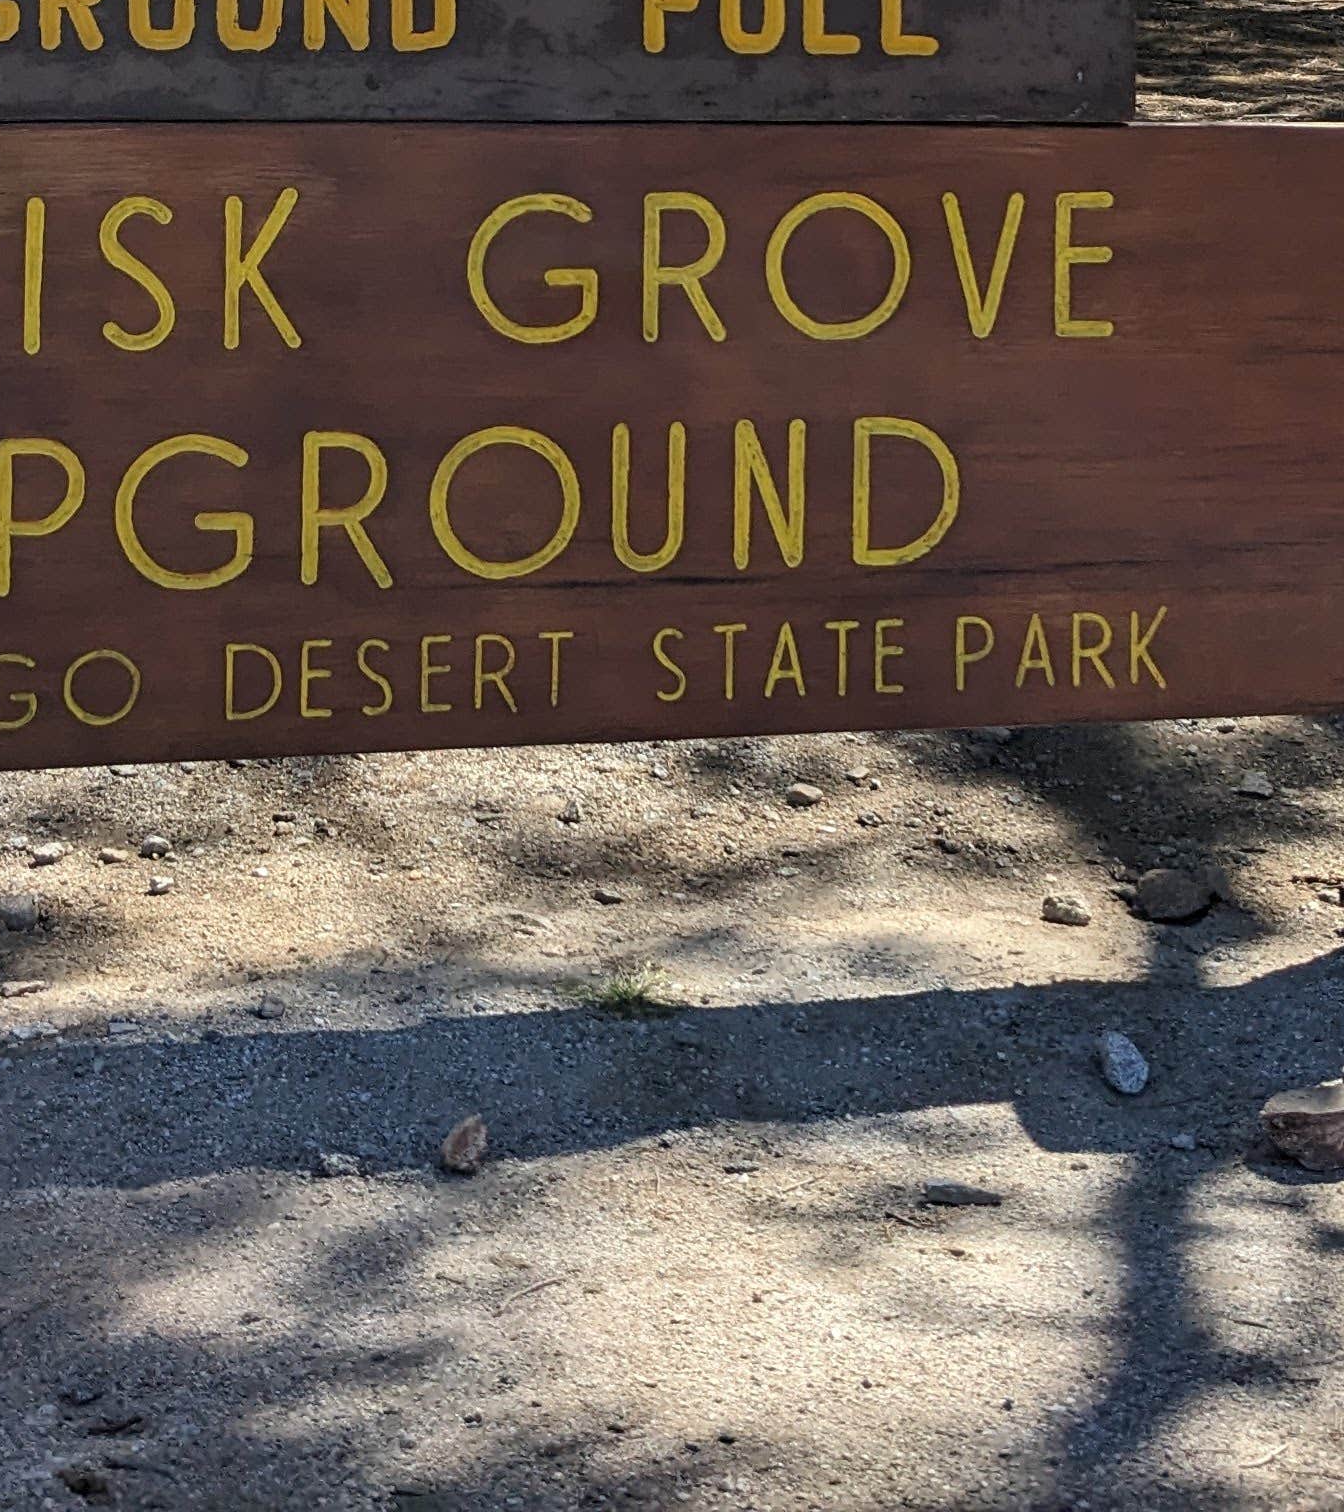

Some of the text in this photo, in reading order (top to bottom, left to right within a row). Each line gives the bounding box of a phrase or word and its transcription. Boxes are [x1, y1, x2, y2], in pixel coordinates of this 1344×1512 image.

[466, 190, 1115, 345] GROVE
[225, 631, 573, 722] DESERT
[653, 618, 905, 702] STATE
[955, 606, 1167, 692] PARK
